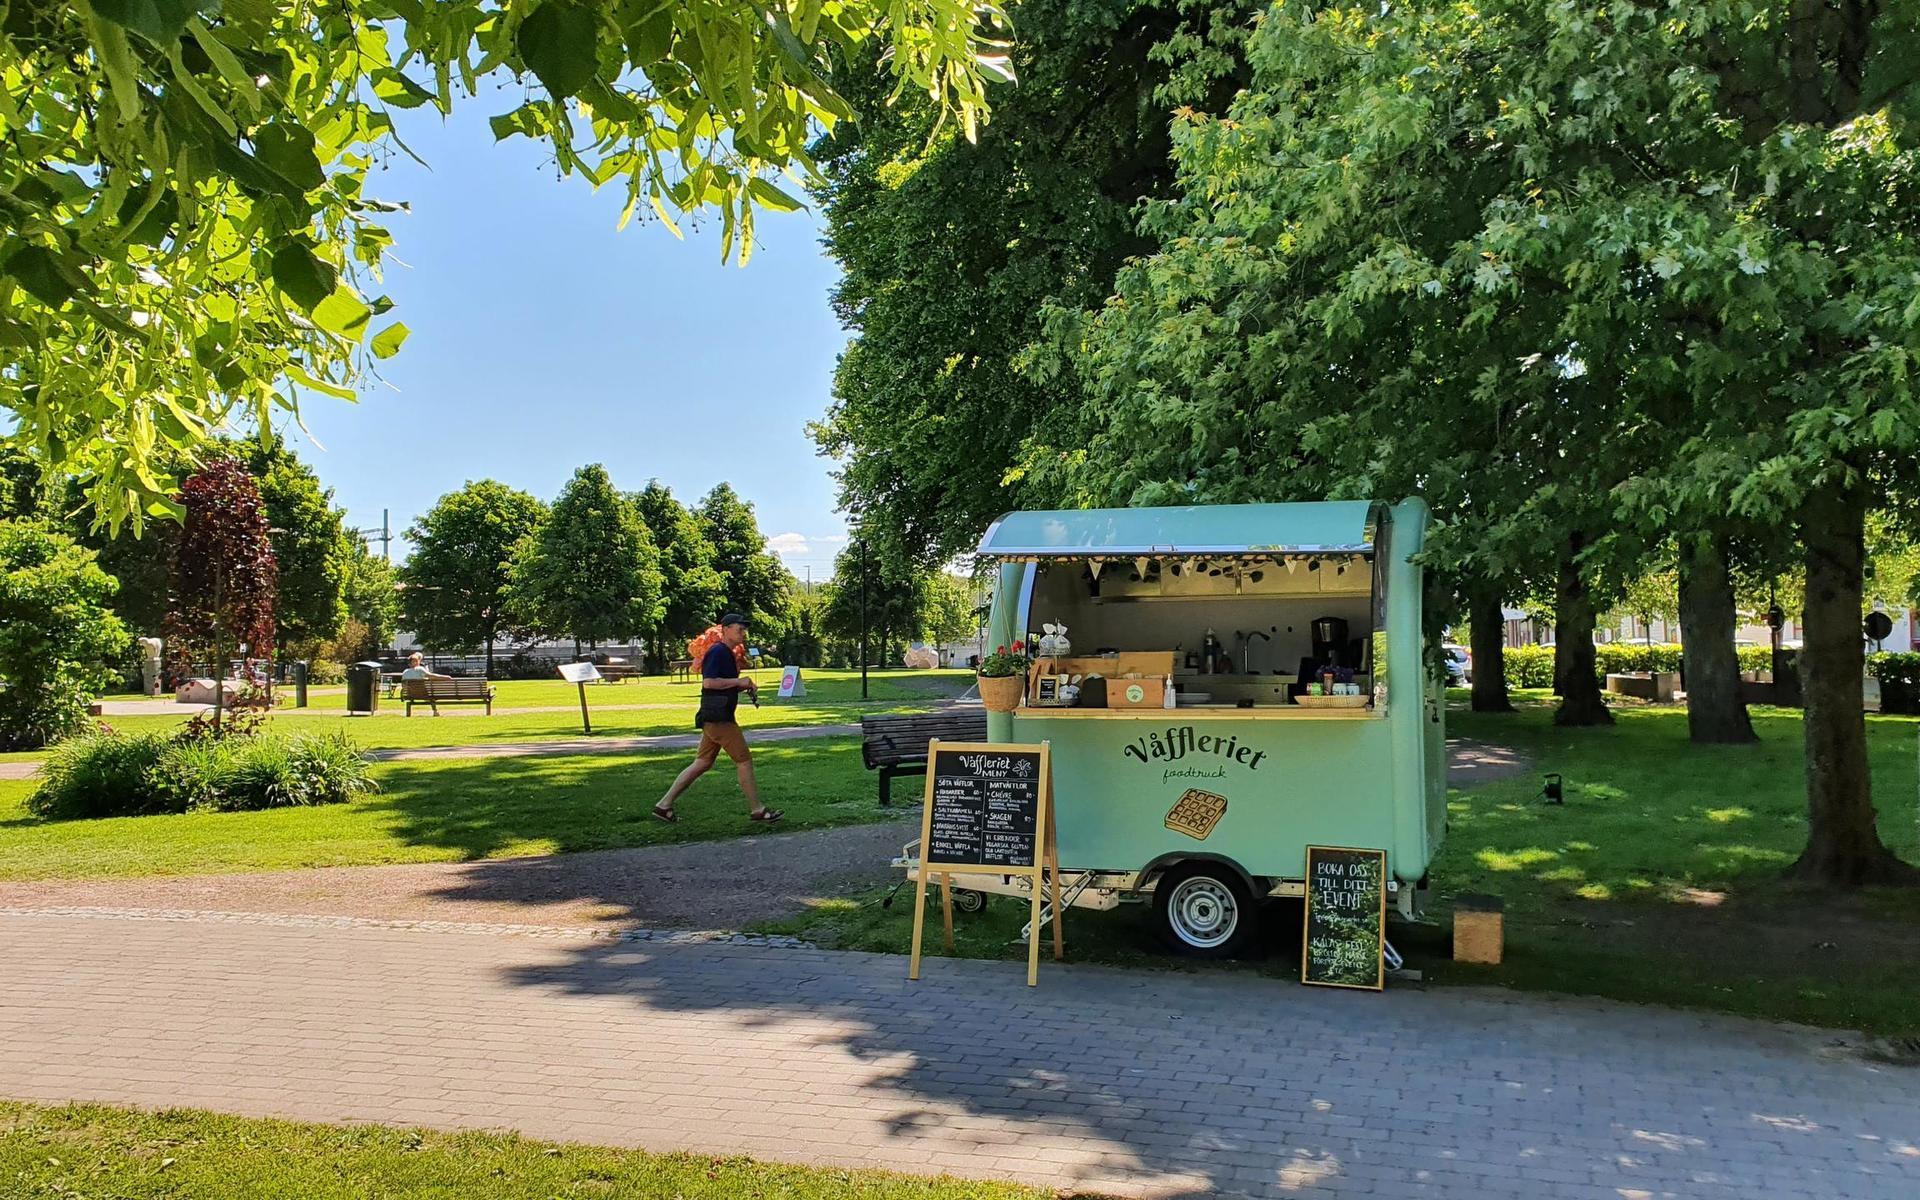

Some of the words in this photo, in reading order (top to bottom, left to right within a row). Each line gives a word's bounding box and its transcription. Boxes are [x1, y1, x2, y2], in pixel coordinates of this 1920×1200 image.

[1124, 726, 1268, 771] Våffleriet
[959, 754, 1011, 775] Våffleriet
[1163, 765, 1227, 784] foodtruck
[1317, 862, 1344, 875] BOKA
[1349, 863, 1368, 877] OSS
[1318, 878, 1339, 889] TILL
[1323, 890, 1361, 908] EVENT
